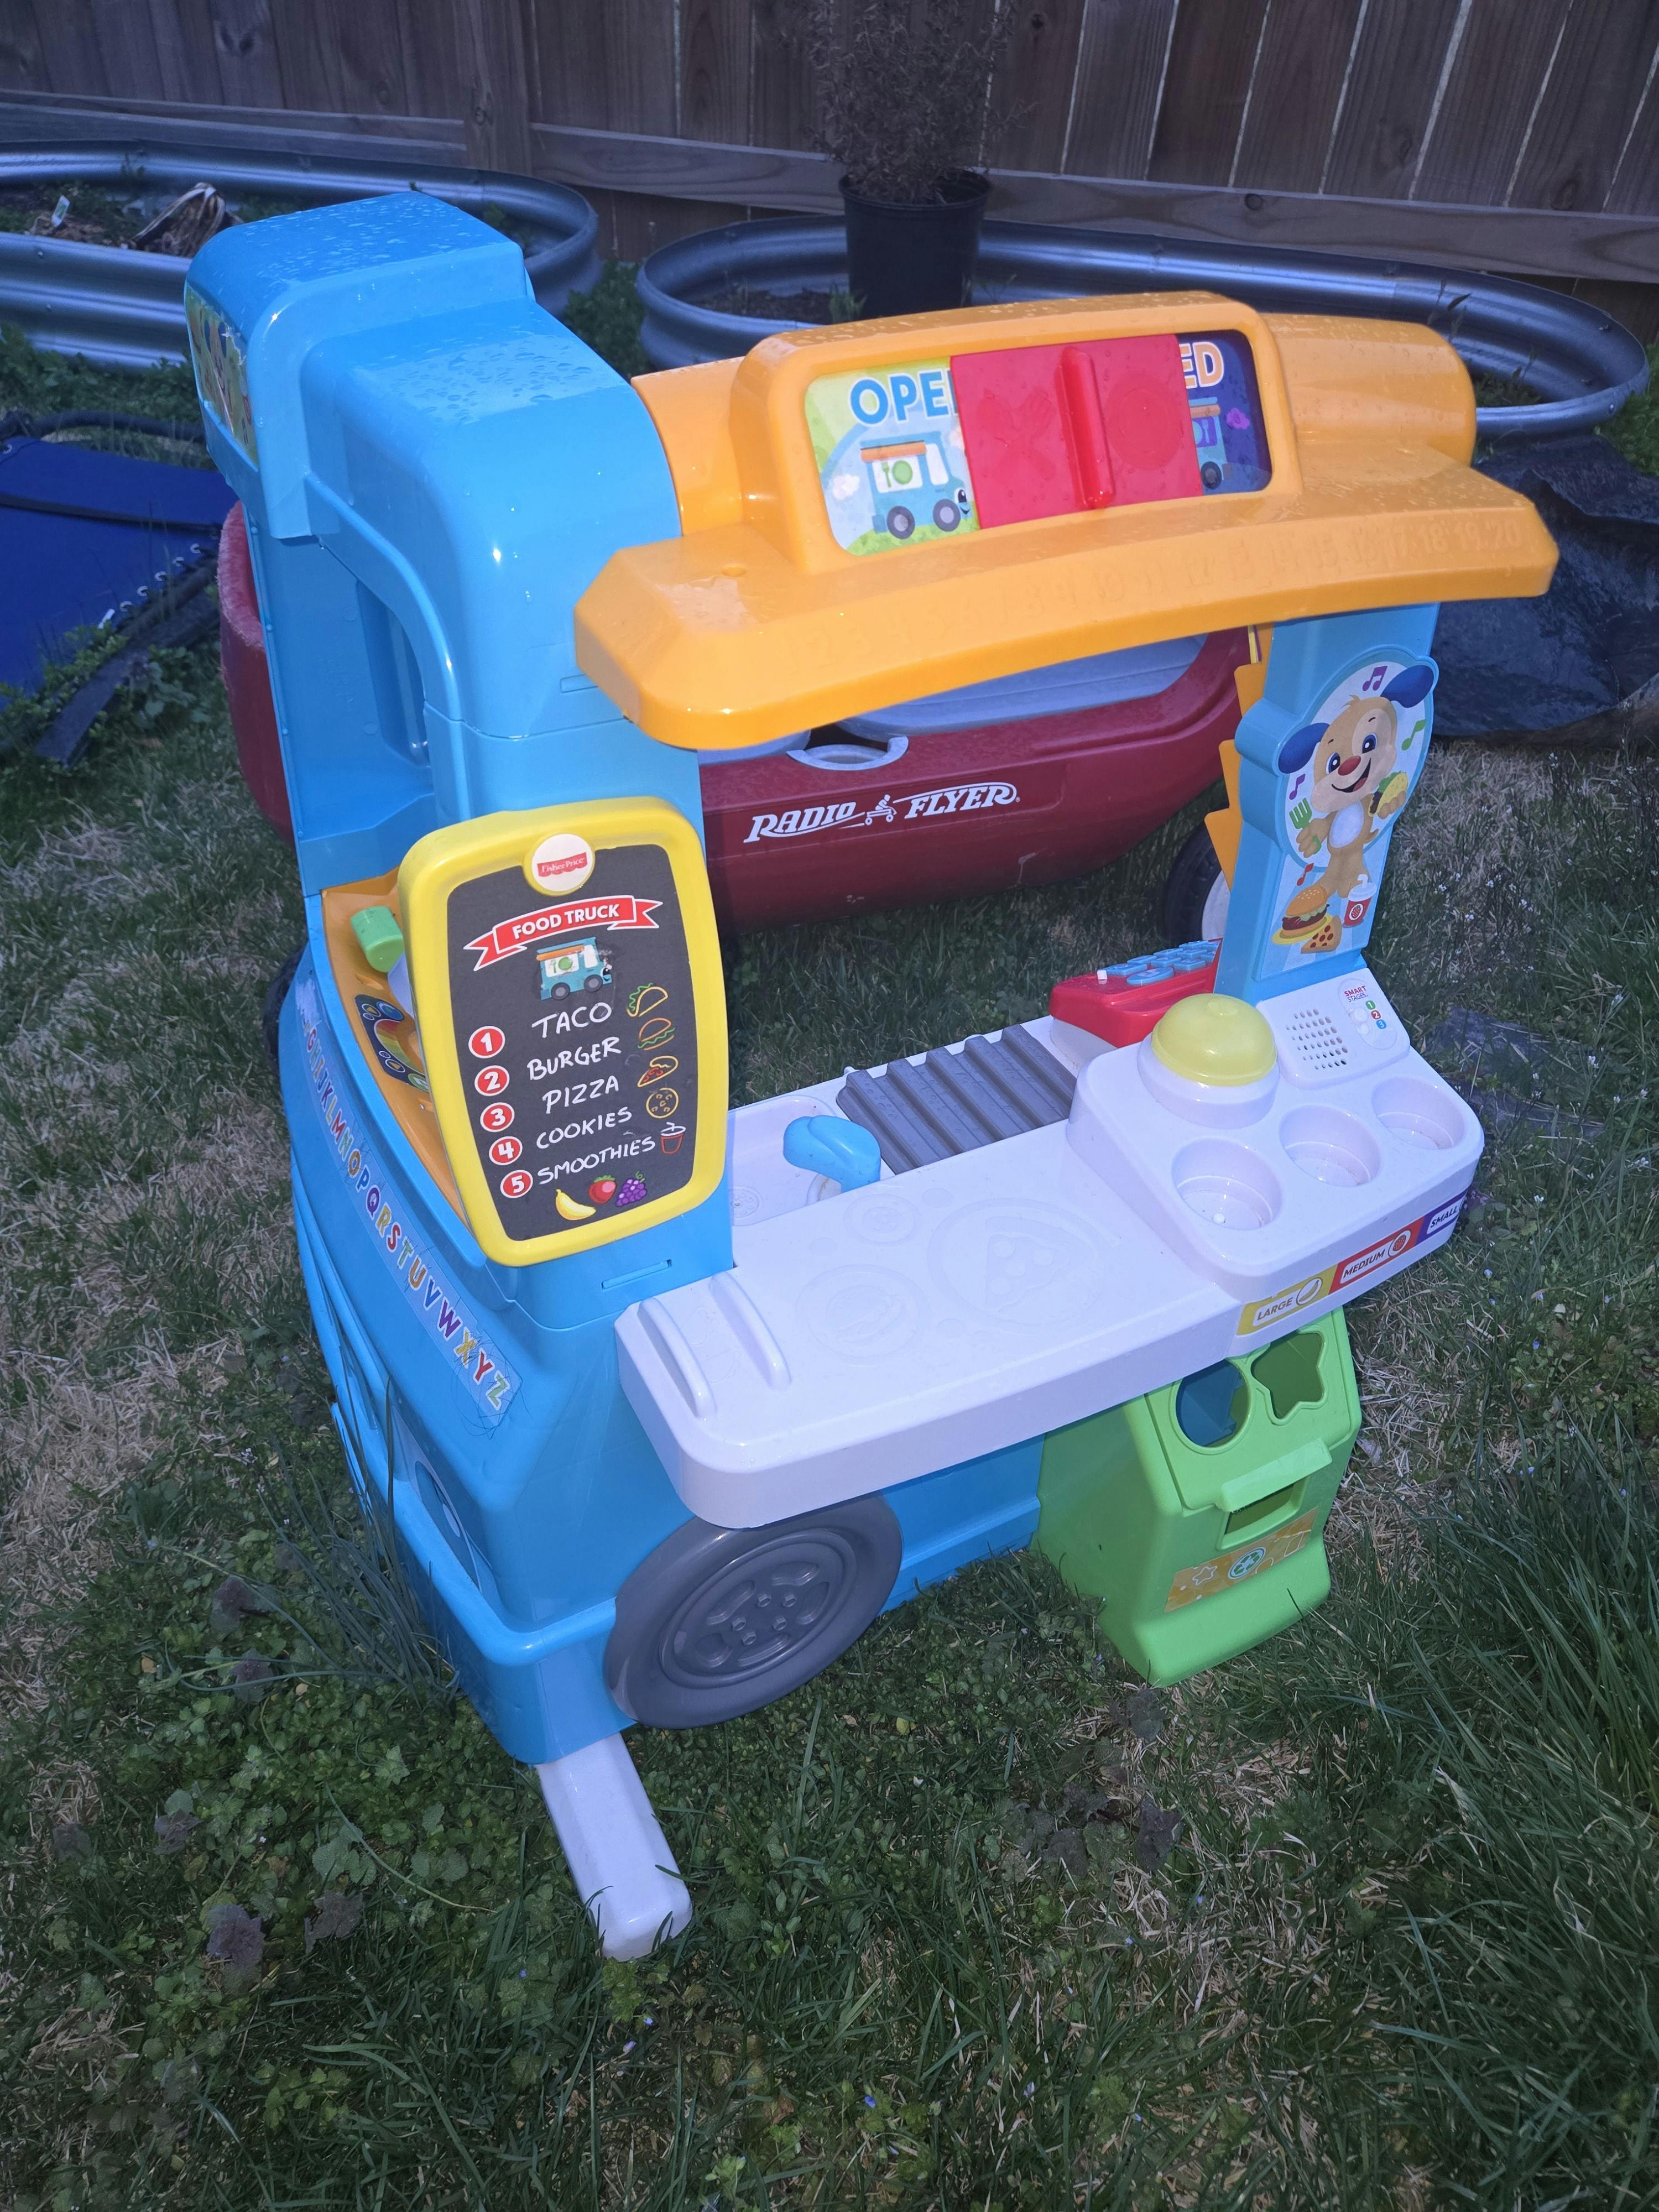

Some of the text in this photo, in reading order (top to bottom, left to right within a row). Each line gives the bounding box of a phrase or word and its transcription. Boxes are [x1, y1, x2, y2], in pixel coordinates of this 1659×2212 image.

[848, 367, 959, 427] OPE
[743, 802, 857, 843] RADIO
[512, 904, 620, 940] FOOD TRUCK
[1344, 985, 1366, 997] SMART
[480, 1002, 612, 1053] 1 TACO
[484, 1036, 622, 1092] 2 BURGER
[490, 1075, 619, 1126] 3 PIZZA
[498, 1107, 632, 1160] 4 COOKIES
[510, 1136, 656, 1193] 5 SMOOTHIES
[1430, 1206, 1458, 1228] SMALL
[1343, 1249, 1386, 1279] MEDIUM
[1256, 1296, 1295, 1322] LARGE
